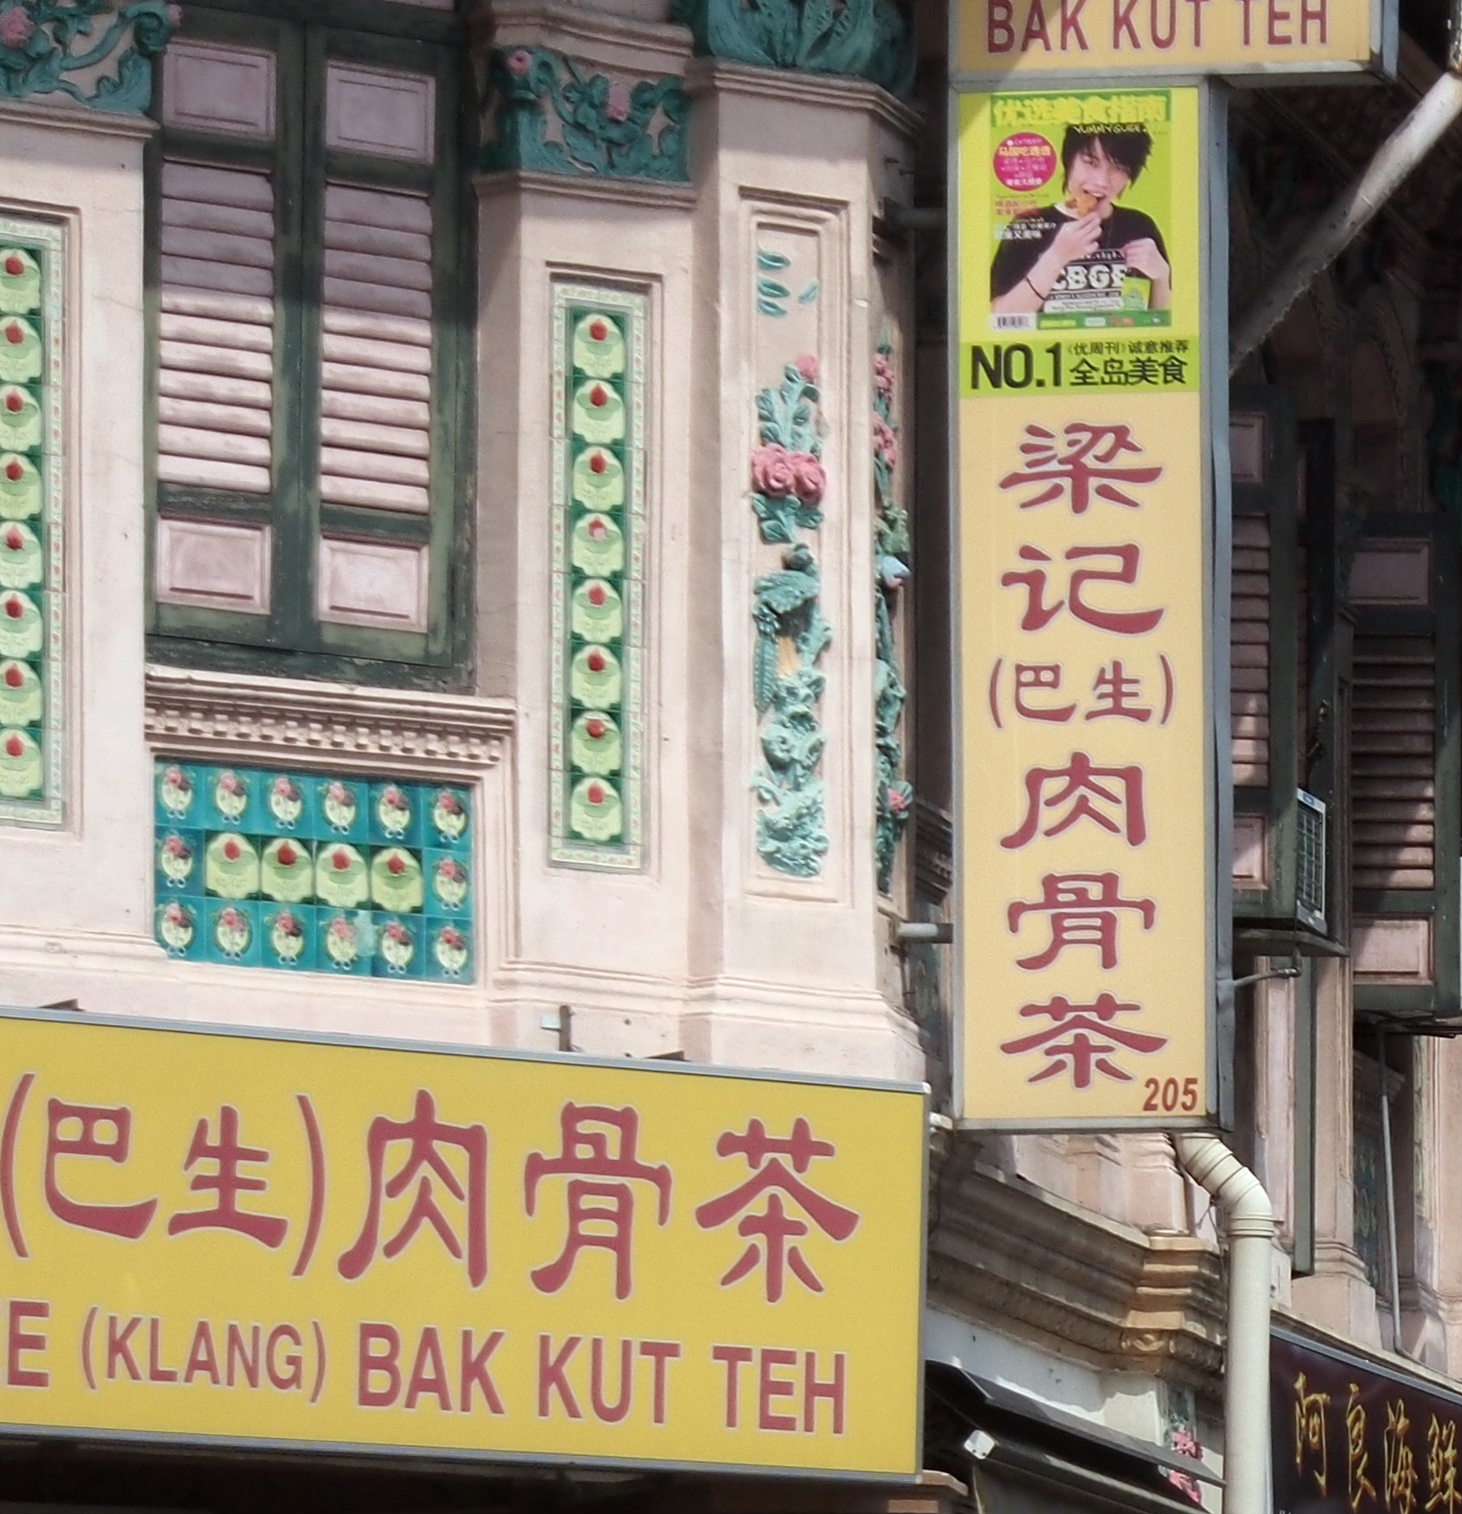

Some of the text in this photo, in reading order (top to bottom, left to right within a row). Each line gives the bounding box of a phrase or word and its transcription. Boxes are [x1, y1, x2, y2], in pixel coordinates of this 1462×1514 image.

[987, 0, 1327, 53] BAK KUT TEH
[971, 342, 1062, 389] NO.1
[1069, 356, 1187, 386] 全岛美食
[1143, 1077, 1198, 1112] 205
[82, 1306, 326, 1402] (KLANG)
[359, 1323, 506, 1417] BAK
[540, 1335, 682, 1425] KUT
[713, 1345, 845, 1436] TEH
